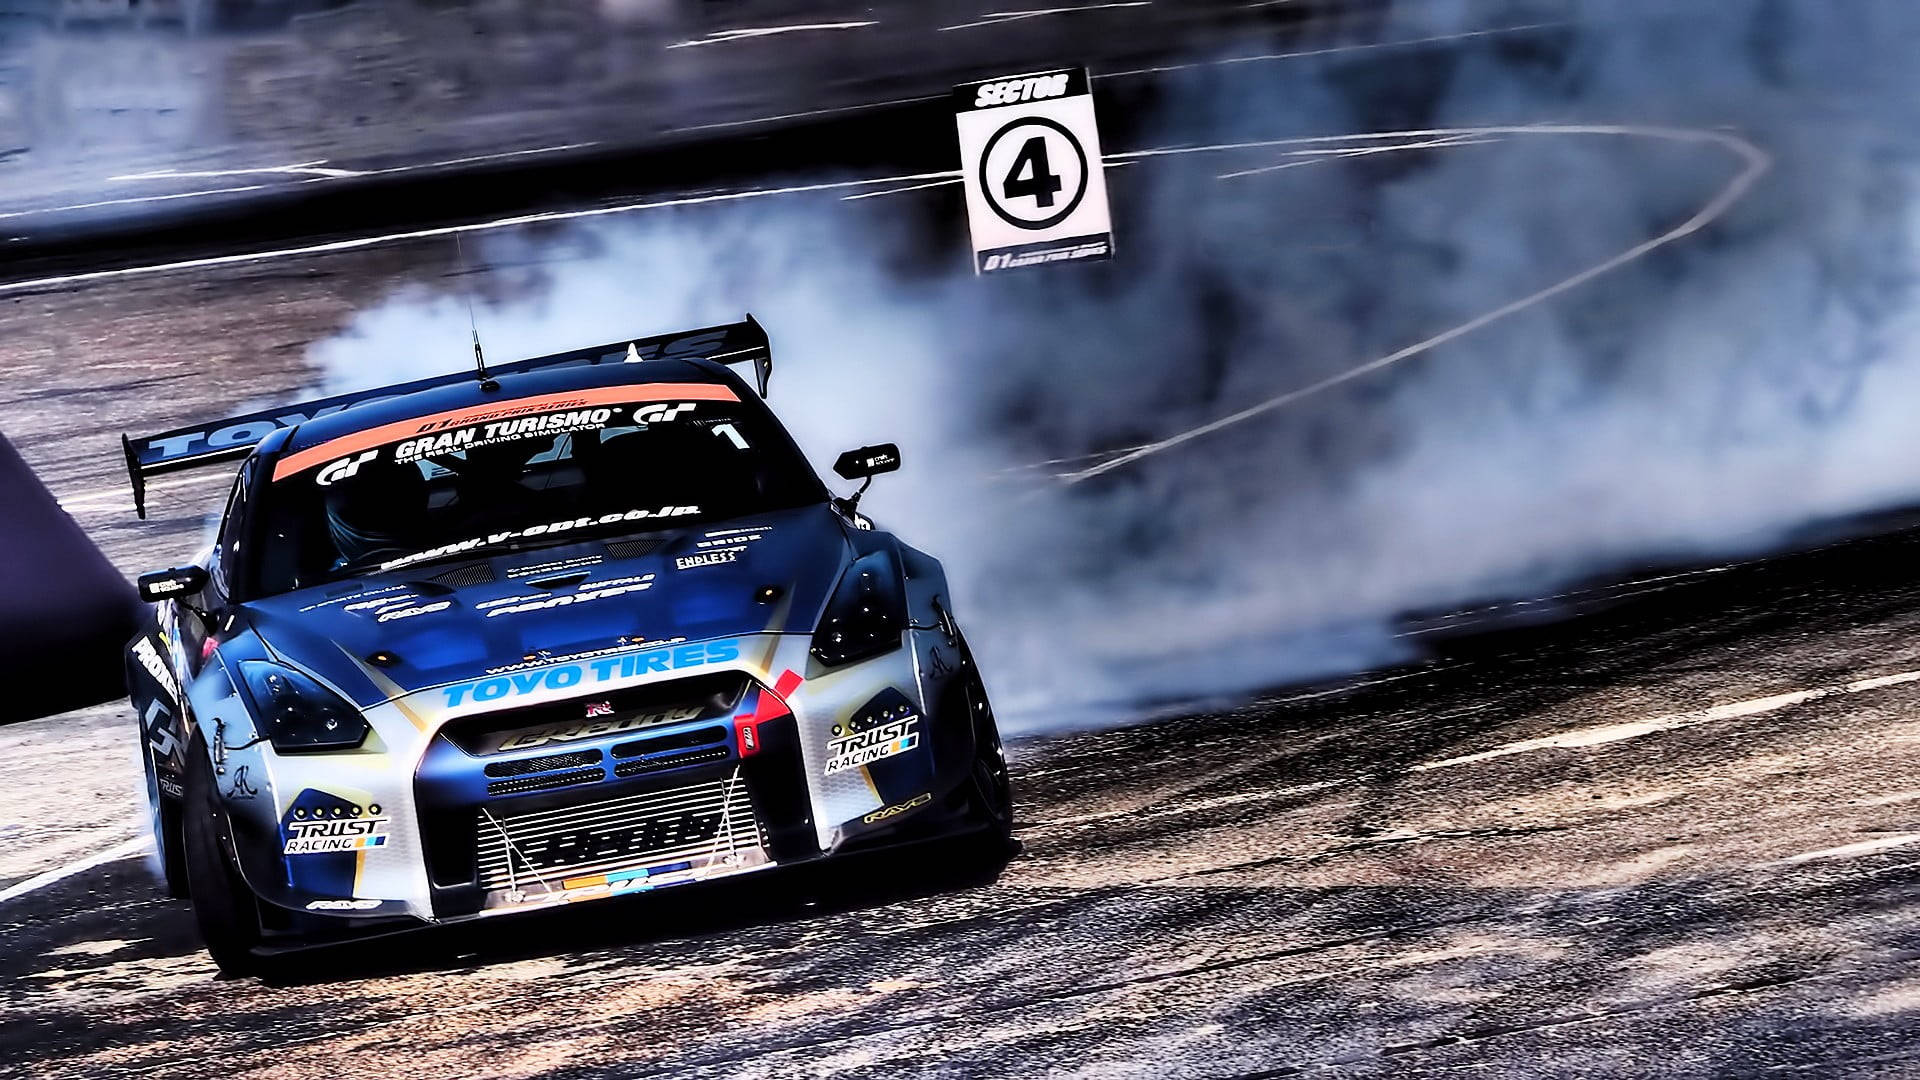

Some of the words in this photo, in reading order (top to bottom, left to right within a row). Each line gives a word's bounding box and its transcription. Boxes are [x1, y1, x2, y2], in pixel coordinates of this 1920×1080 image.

[1003, 136, 1062, 208] 4
[394, 454, 423, 465] THE
[425, 446, 462, 458] REAL
[464, 433, 522, 450] DRIVING
[524, 422, 606, 439] SIMULATOR
[395, 428, 476, 458] GRAN
[485, 409, 611, 439] TURISMO
[711, 424, 750, 449] 1
[676, 551, 737, 570] ENDLESS
[442, 666, 583, 708] TOYO
[591, 639, 740, 681] TIRES
[827, 744, 889, 773] RACING
[287, 838, 352, 852] RACING
